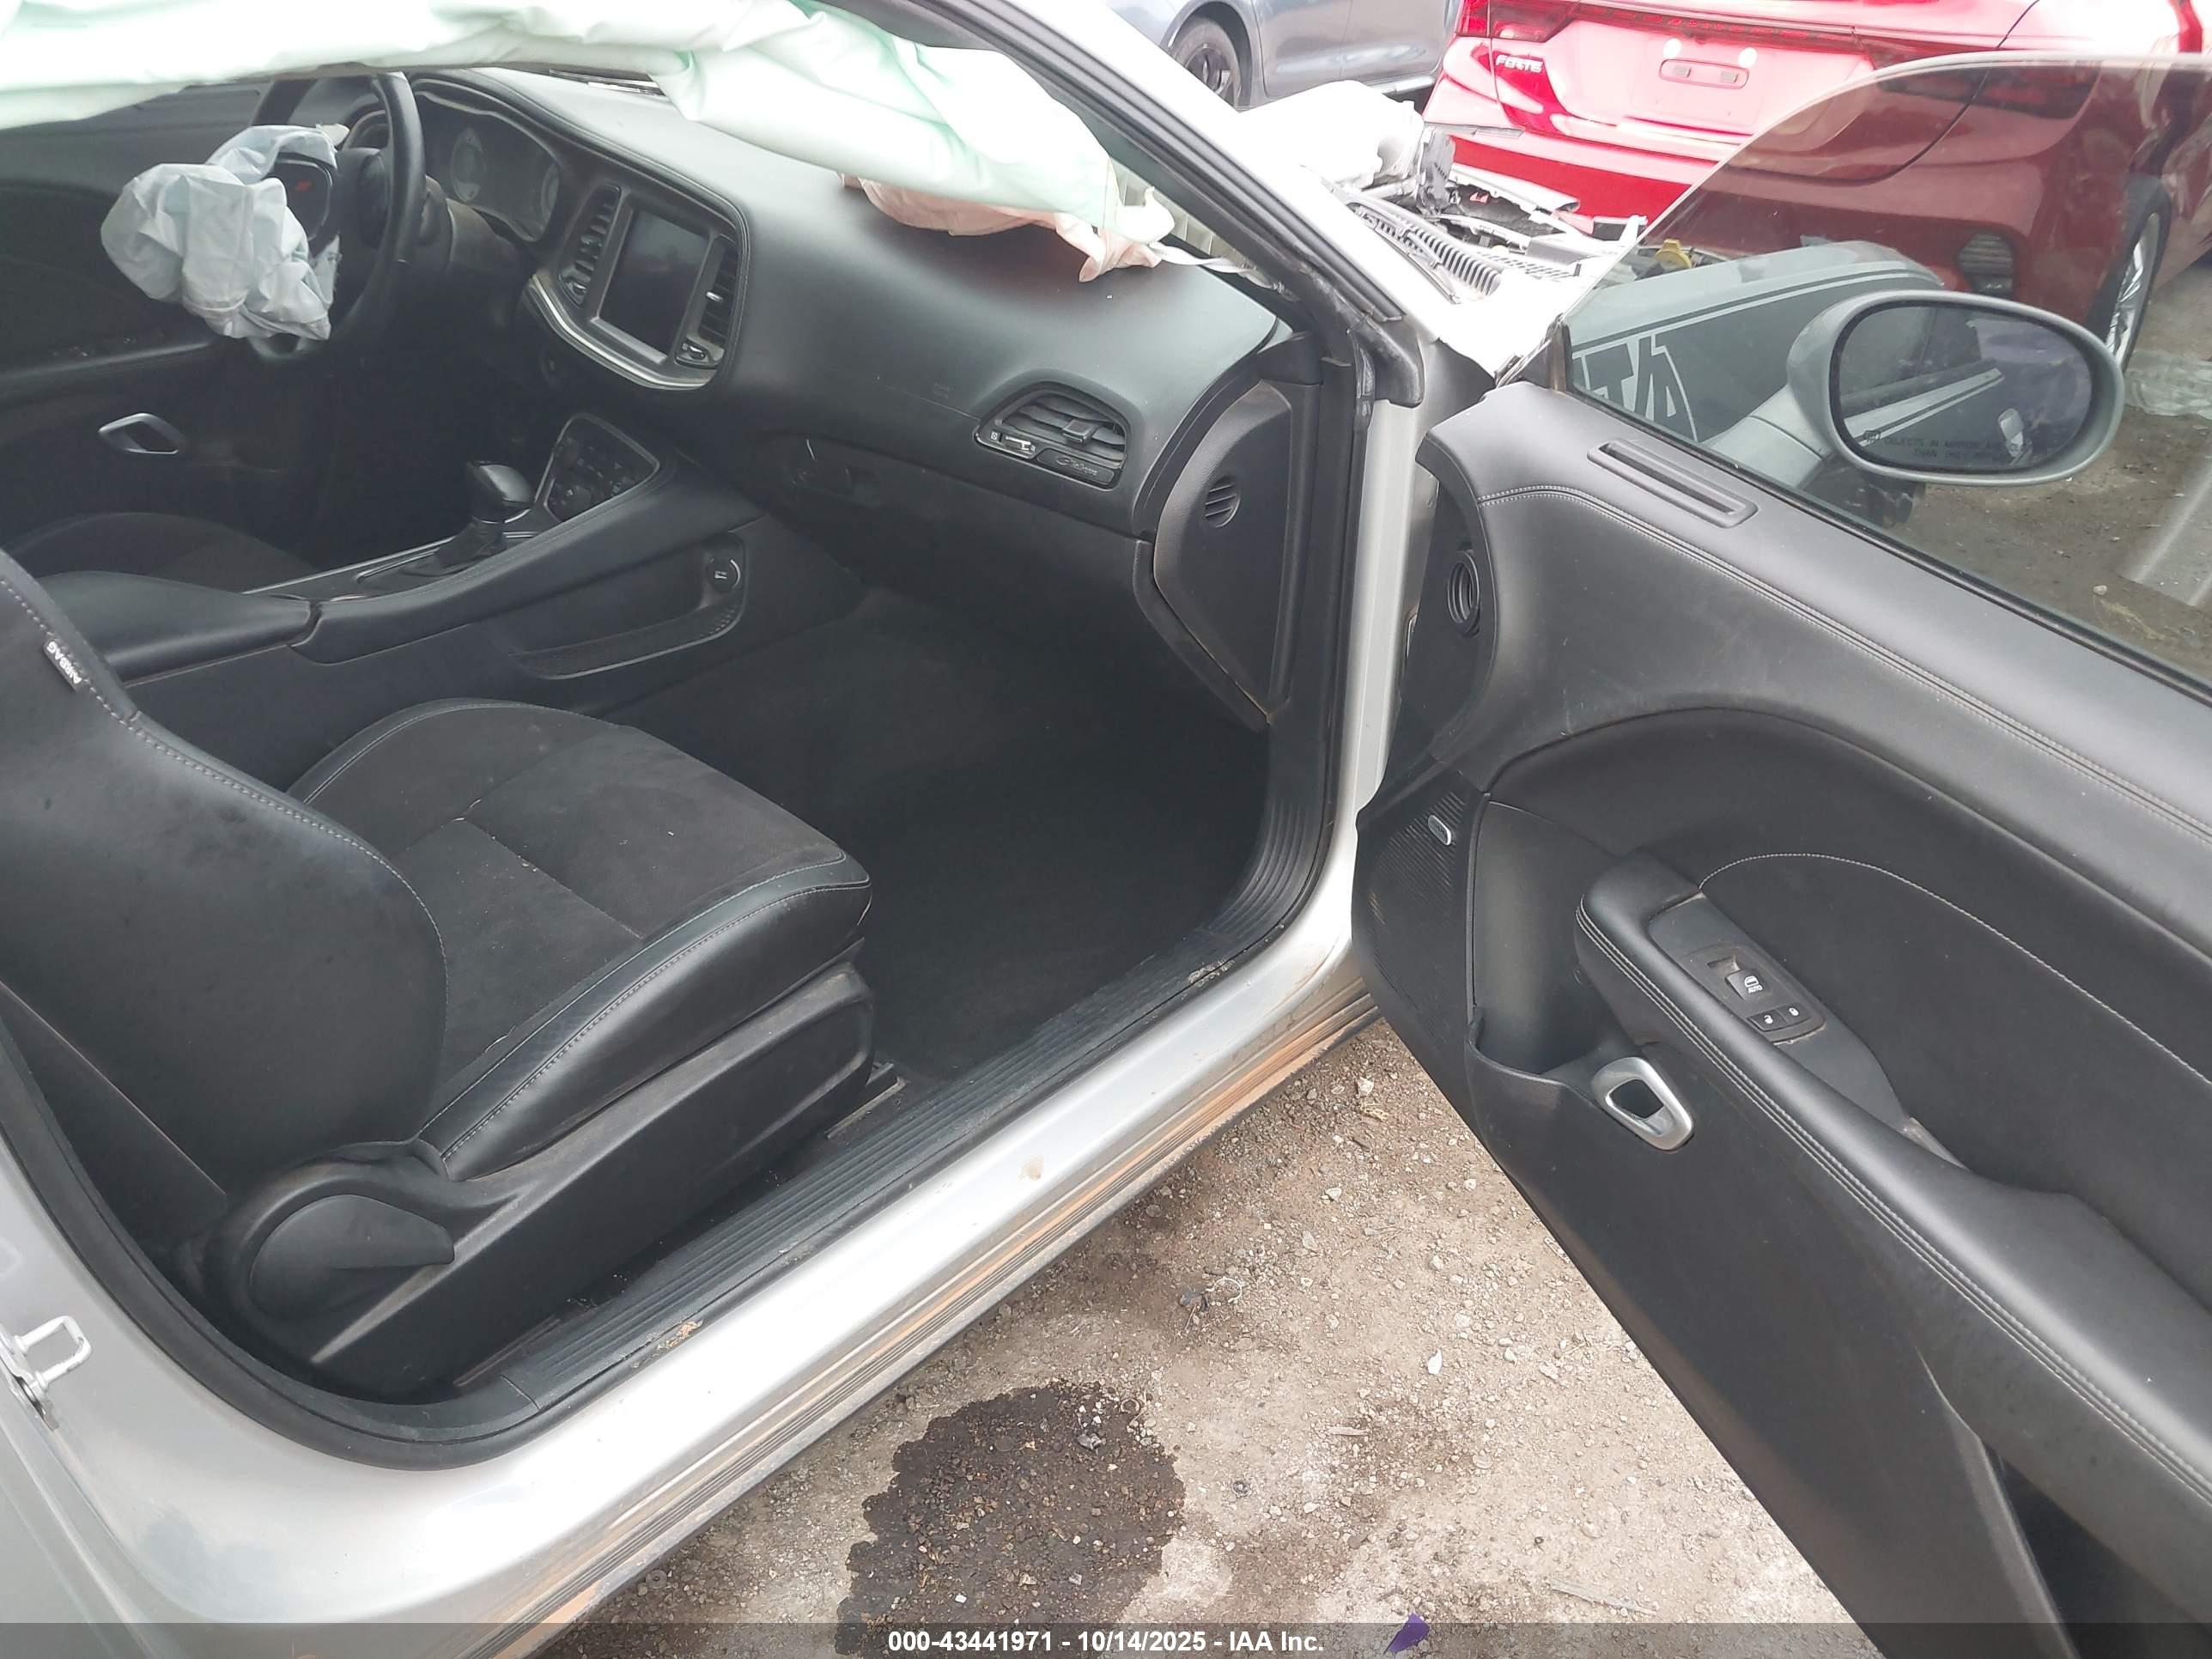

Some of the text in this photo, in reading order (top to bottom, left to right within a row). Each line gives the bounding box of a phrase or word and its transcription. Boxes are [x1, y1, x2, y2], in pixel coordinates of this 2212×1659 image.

[1495, 54, 1544, 74] FORTE
[46, 641, 82, 684] AIRBAG
[1747, 984, 1763, 994] AUTO
